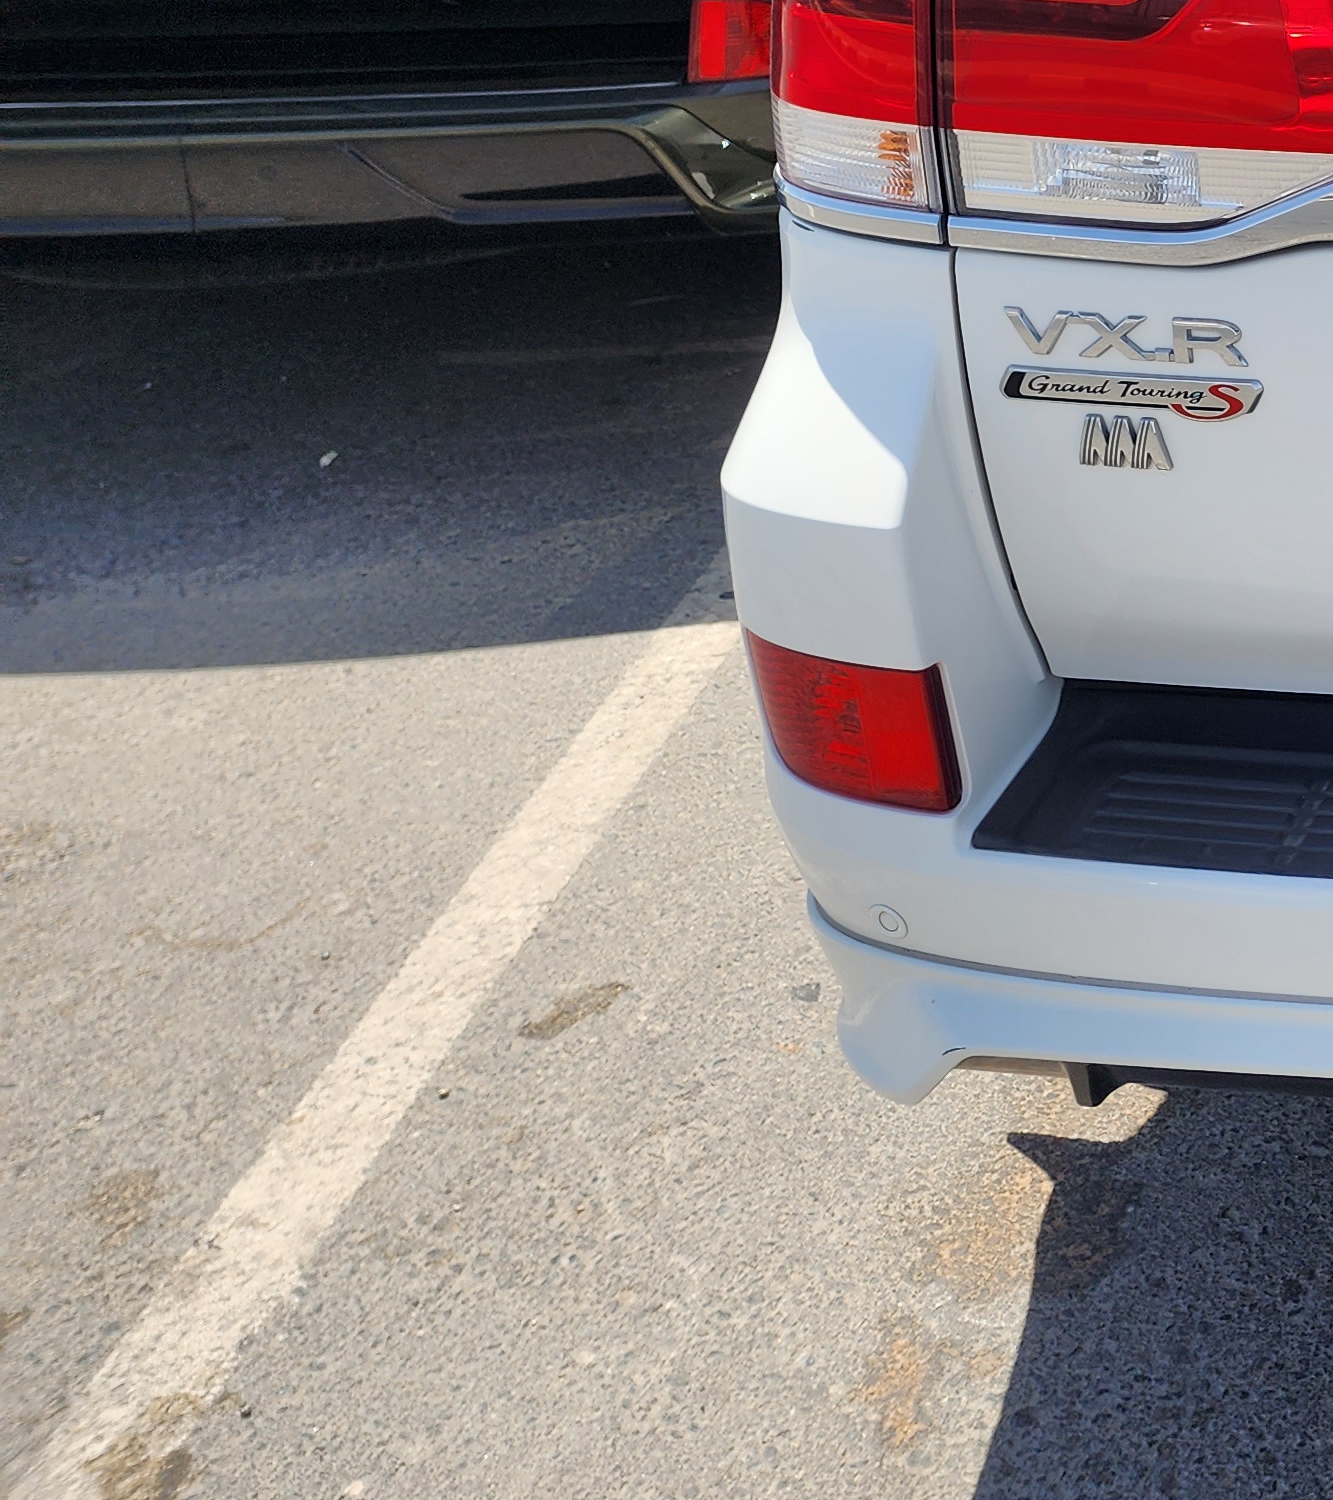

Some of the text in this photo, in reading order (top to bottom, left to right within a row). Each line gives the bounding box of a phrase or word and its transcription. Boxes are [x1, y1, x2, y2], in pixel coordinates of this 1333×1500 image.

[1027, 374, 1245, 423] Grand Touring S
